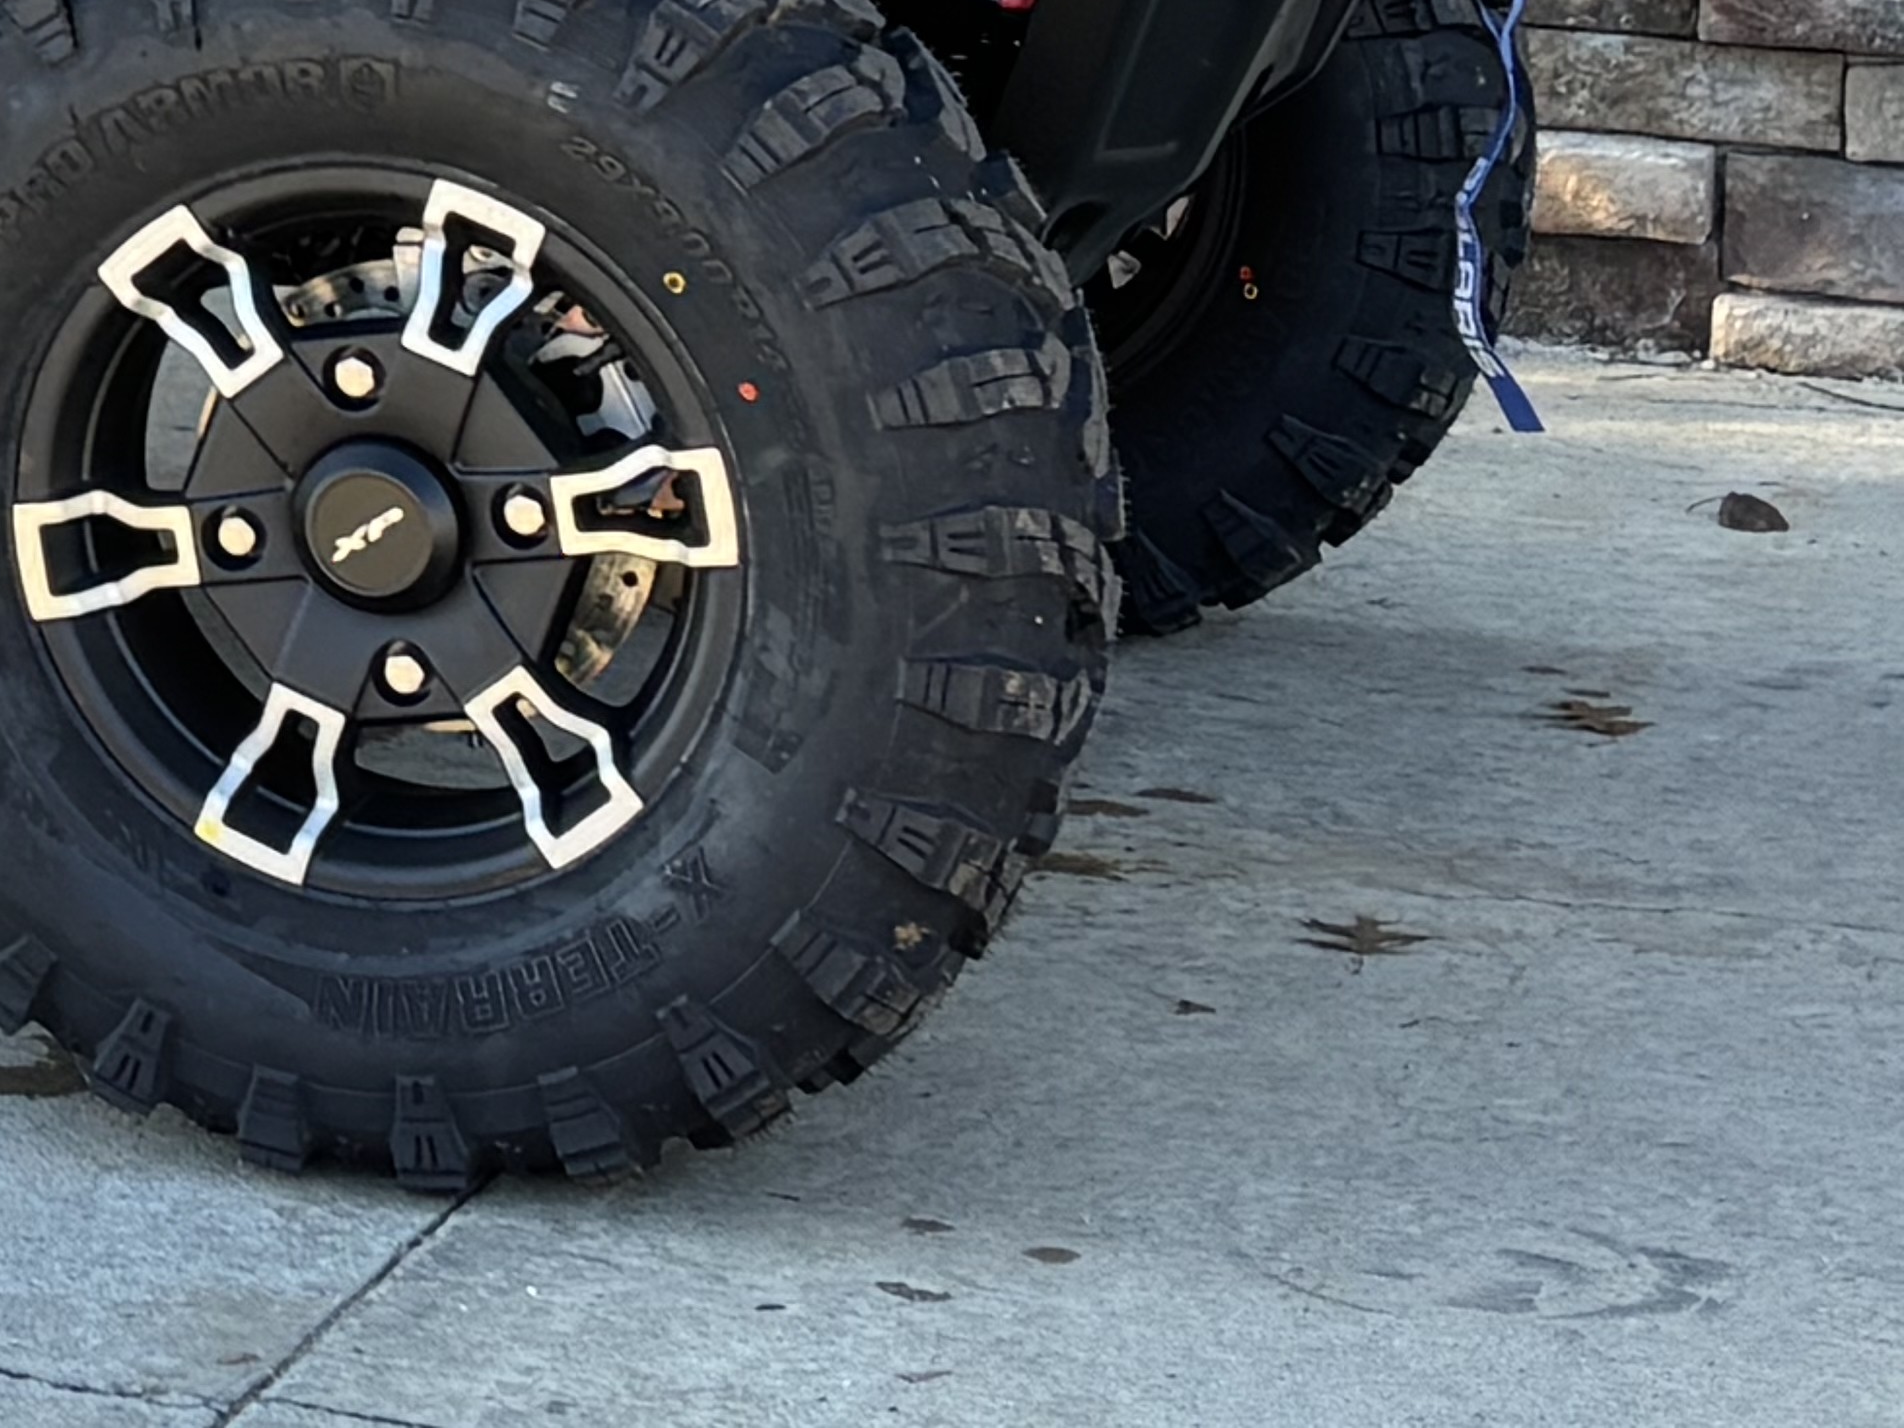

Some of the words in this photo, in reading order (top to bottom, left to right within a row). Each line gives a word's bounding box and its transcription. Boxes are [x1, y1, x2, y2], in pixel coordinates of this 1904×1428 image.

[94, 55, 328, 156] ARMOR
[331, 505, 406, 563] XP
[311, 845, 727, 1036] X-TERRAIN
